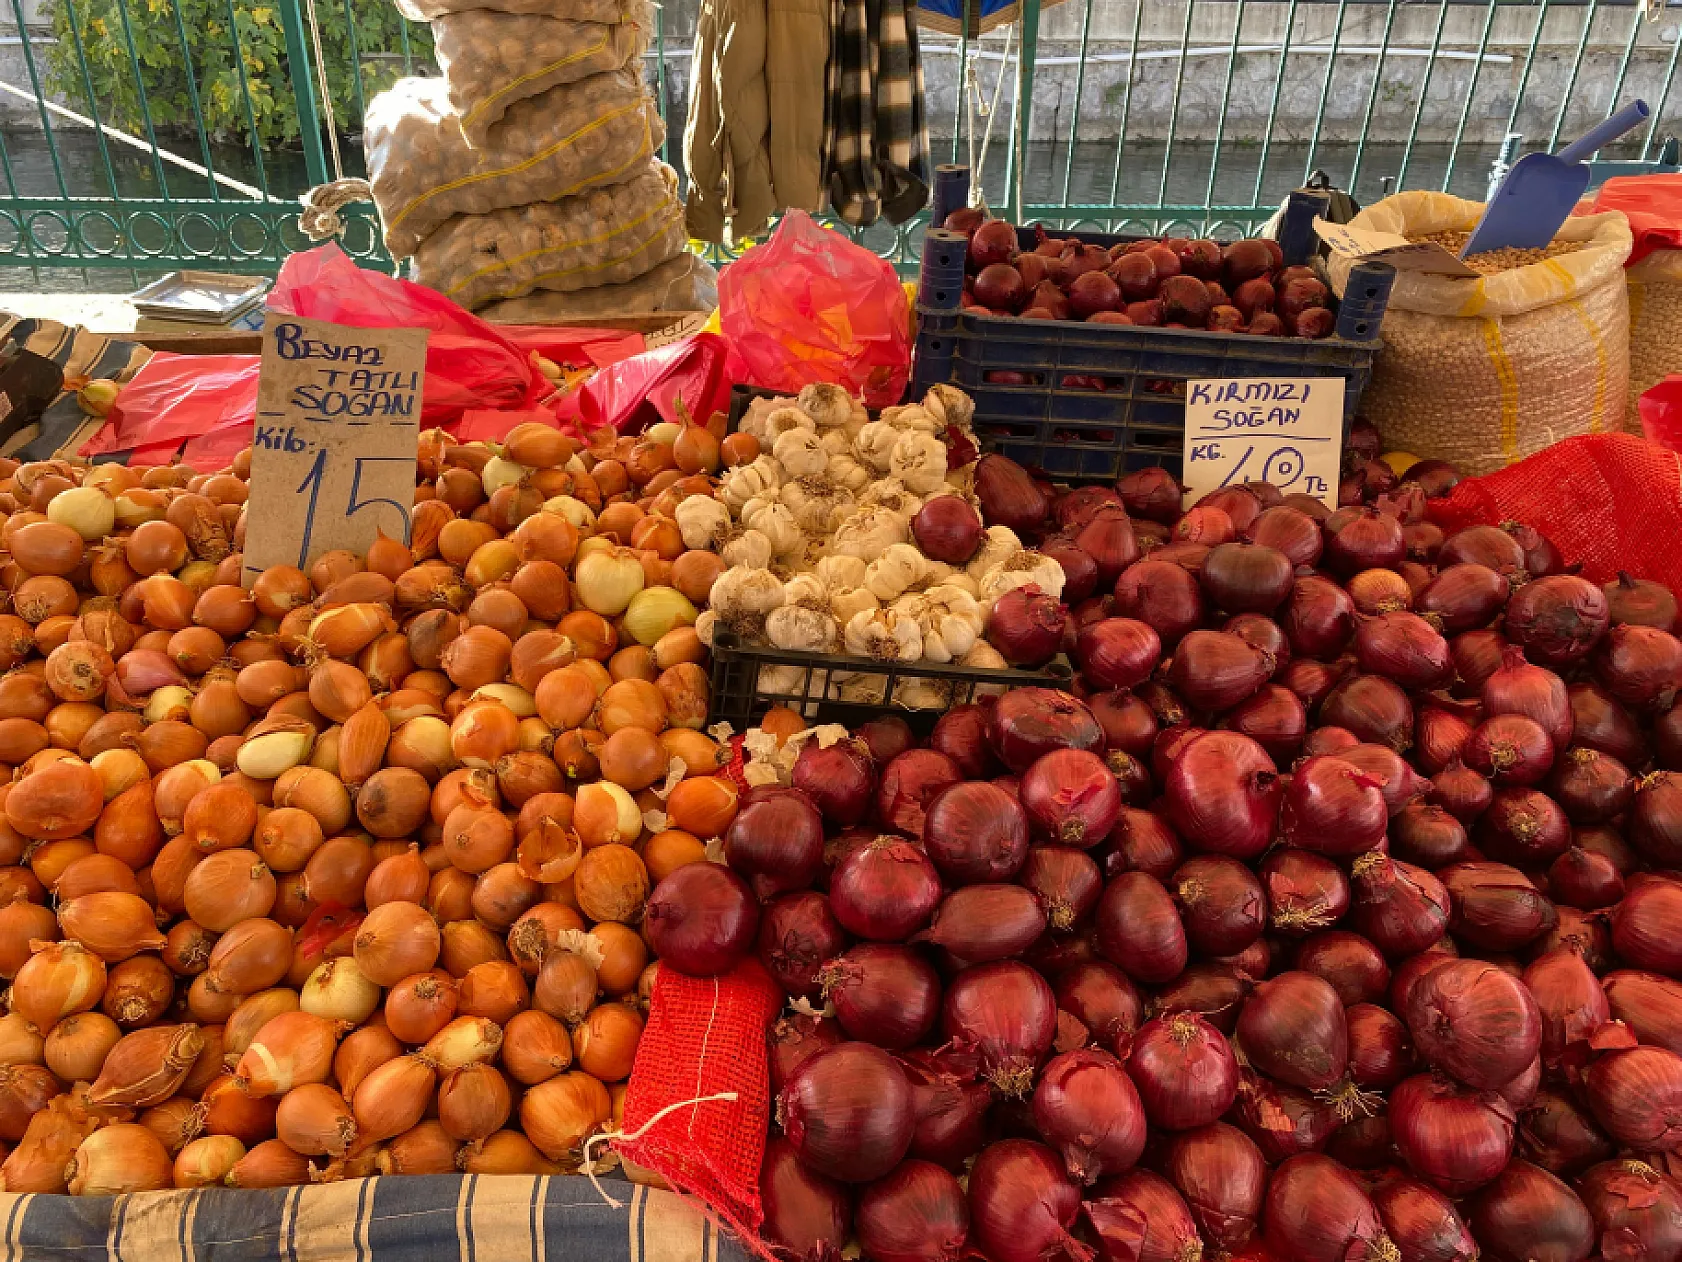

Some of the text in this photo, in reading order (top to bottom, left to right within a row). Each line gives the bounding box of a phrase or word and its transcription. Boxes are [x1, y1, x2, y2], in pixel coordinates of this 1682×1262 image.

[318, 369, 418, 391] TATLI
[1190, 381, 1311, 405] KIRMIZI
[1200, 406, 1301, 430] SOĞAN
[296, 448, 417, 571] 15
